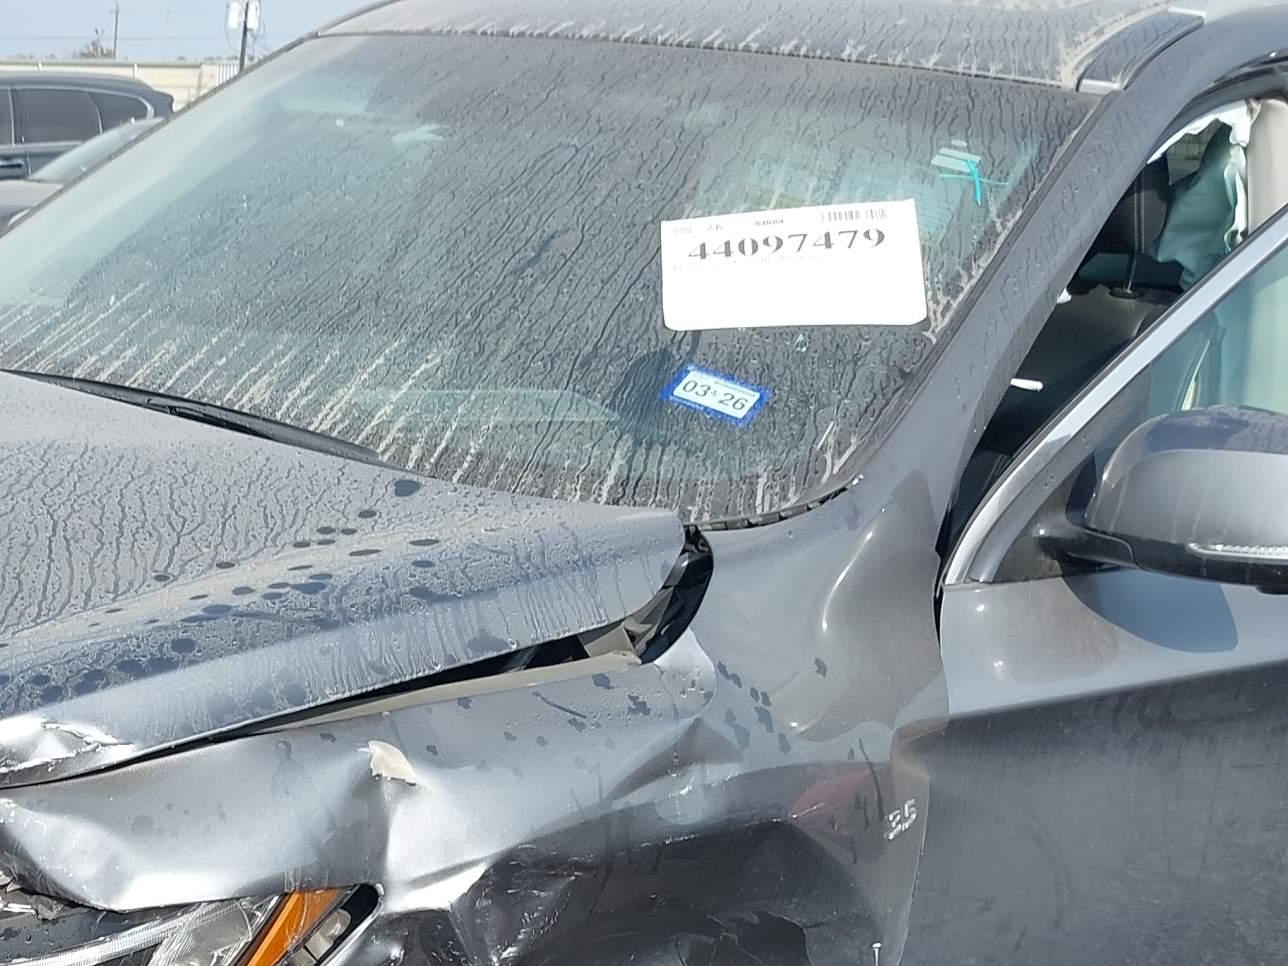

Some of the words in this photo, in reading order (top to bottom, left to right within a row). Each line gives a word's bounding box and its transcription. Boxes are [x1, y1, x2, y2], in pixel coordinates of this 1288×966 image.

[687, 228, 886, 260] 44097479
[681, 379, 712, 398] 03
[719, 392, 749, 411] 26
